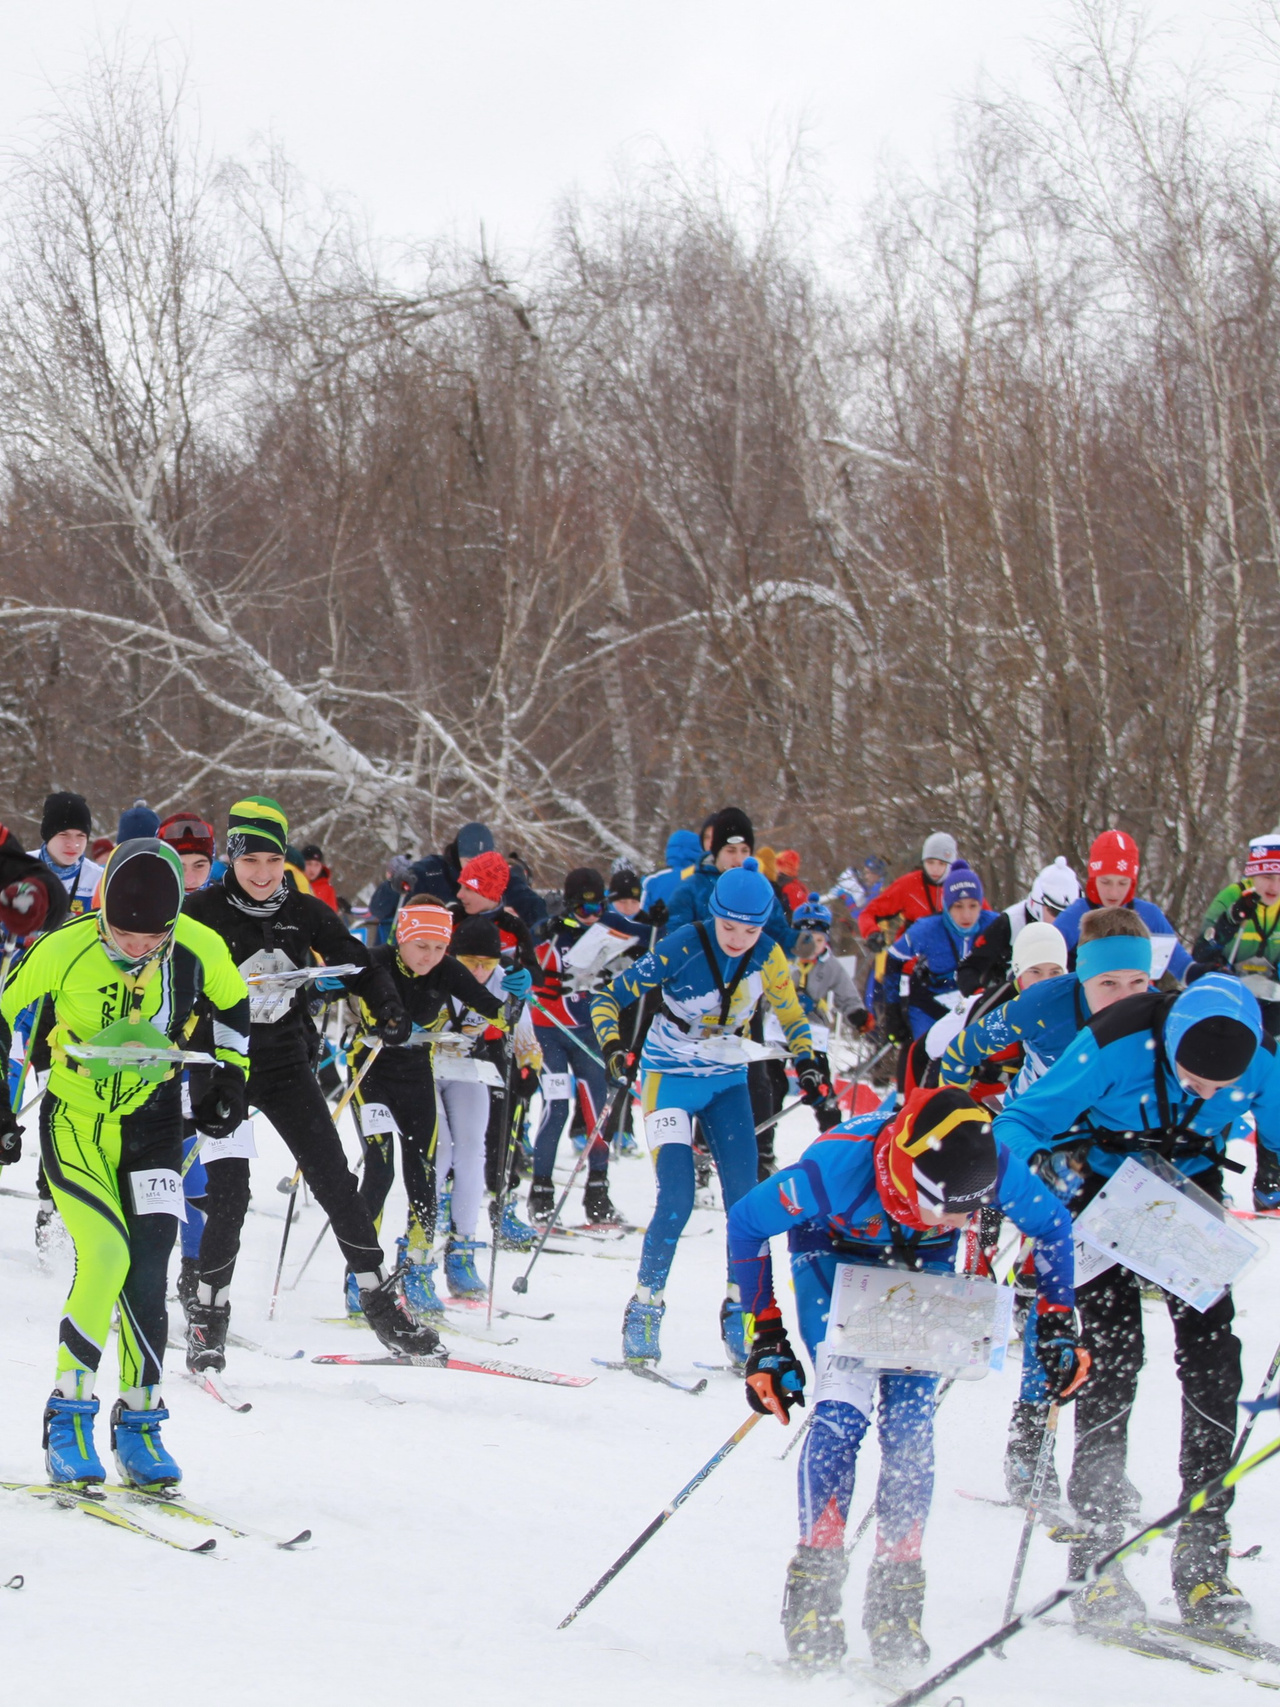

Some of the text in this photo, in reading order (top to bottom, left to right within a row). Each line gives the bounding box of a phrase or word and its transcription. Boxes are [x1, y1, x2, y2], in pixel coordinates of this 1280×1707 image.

[655, 1116, 677, 1128] 735
[147, 1178, 177, 1193] 718
[827, 1353, 866, 1371] 707
